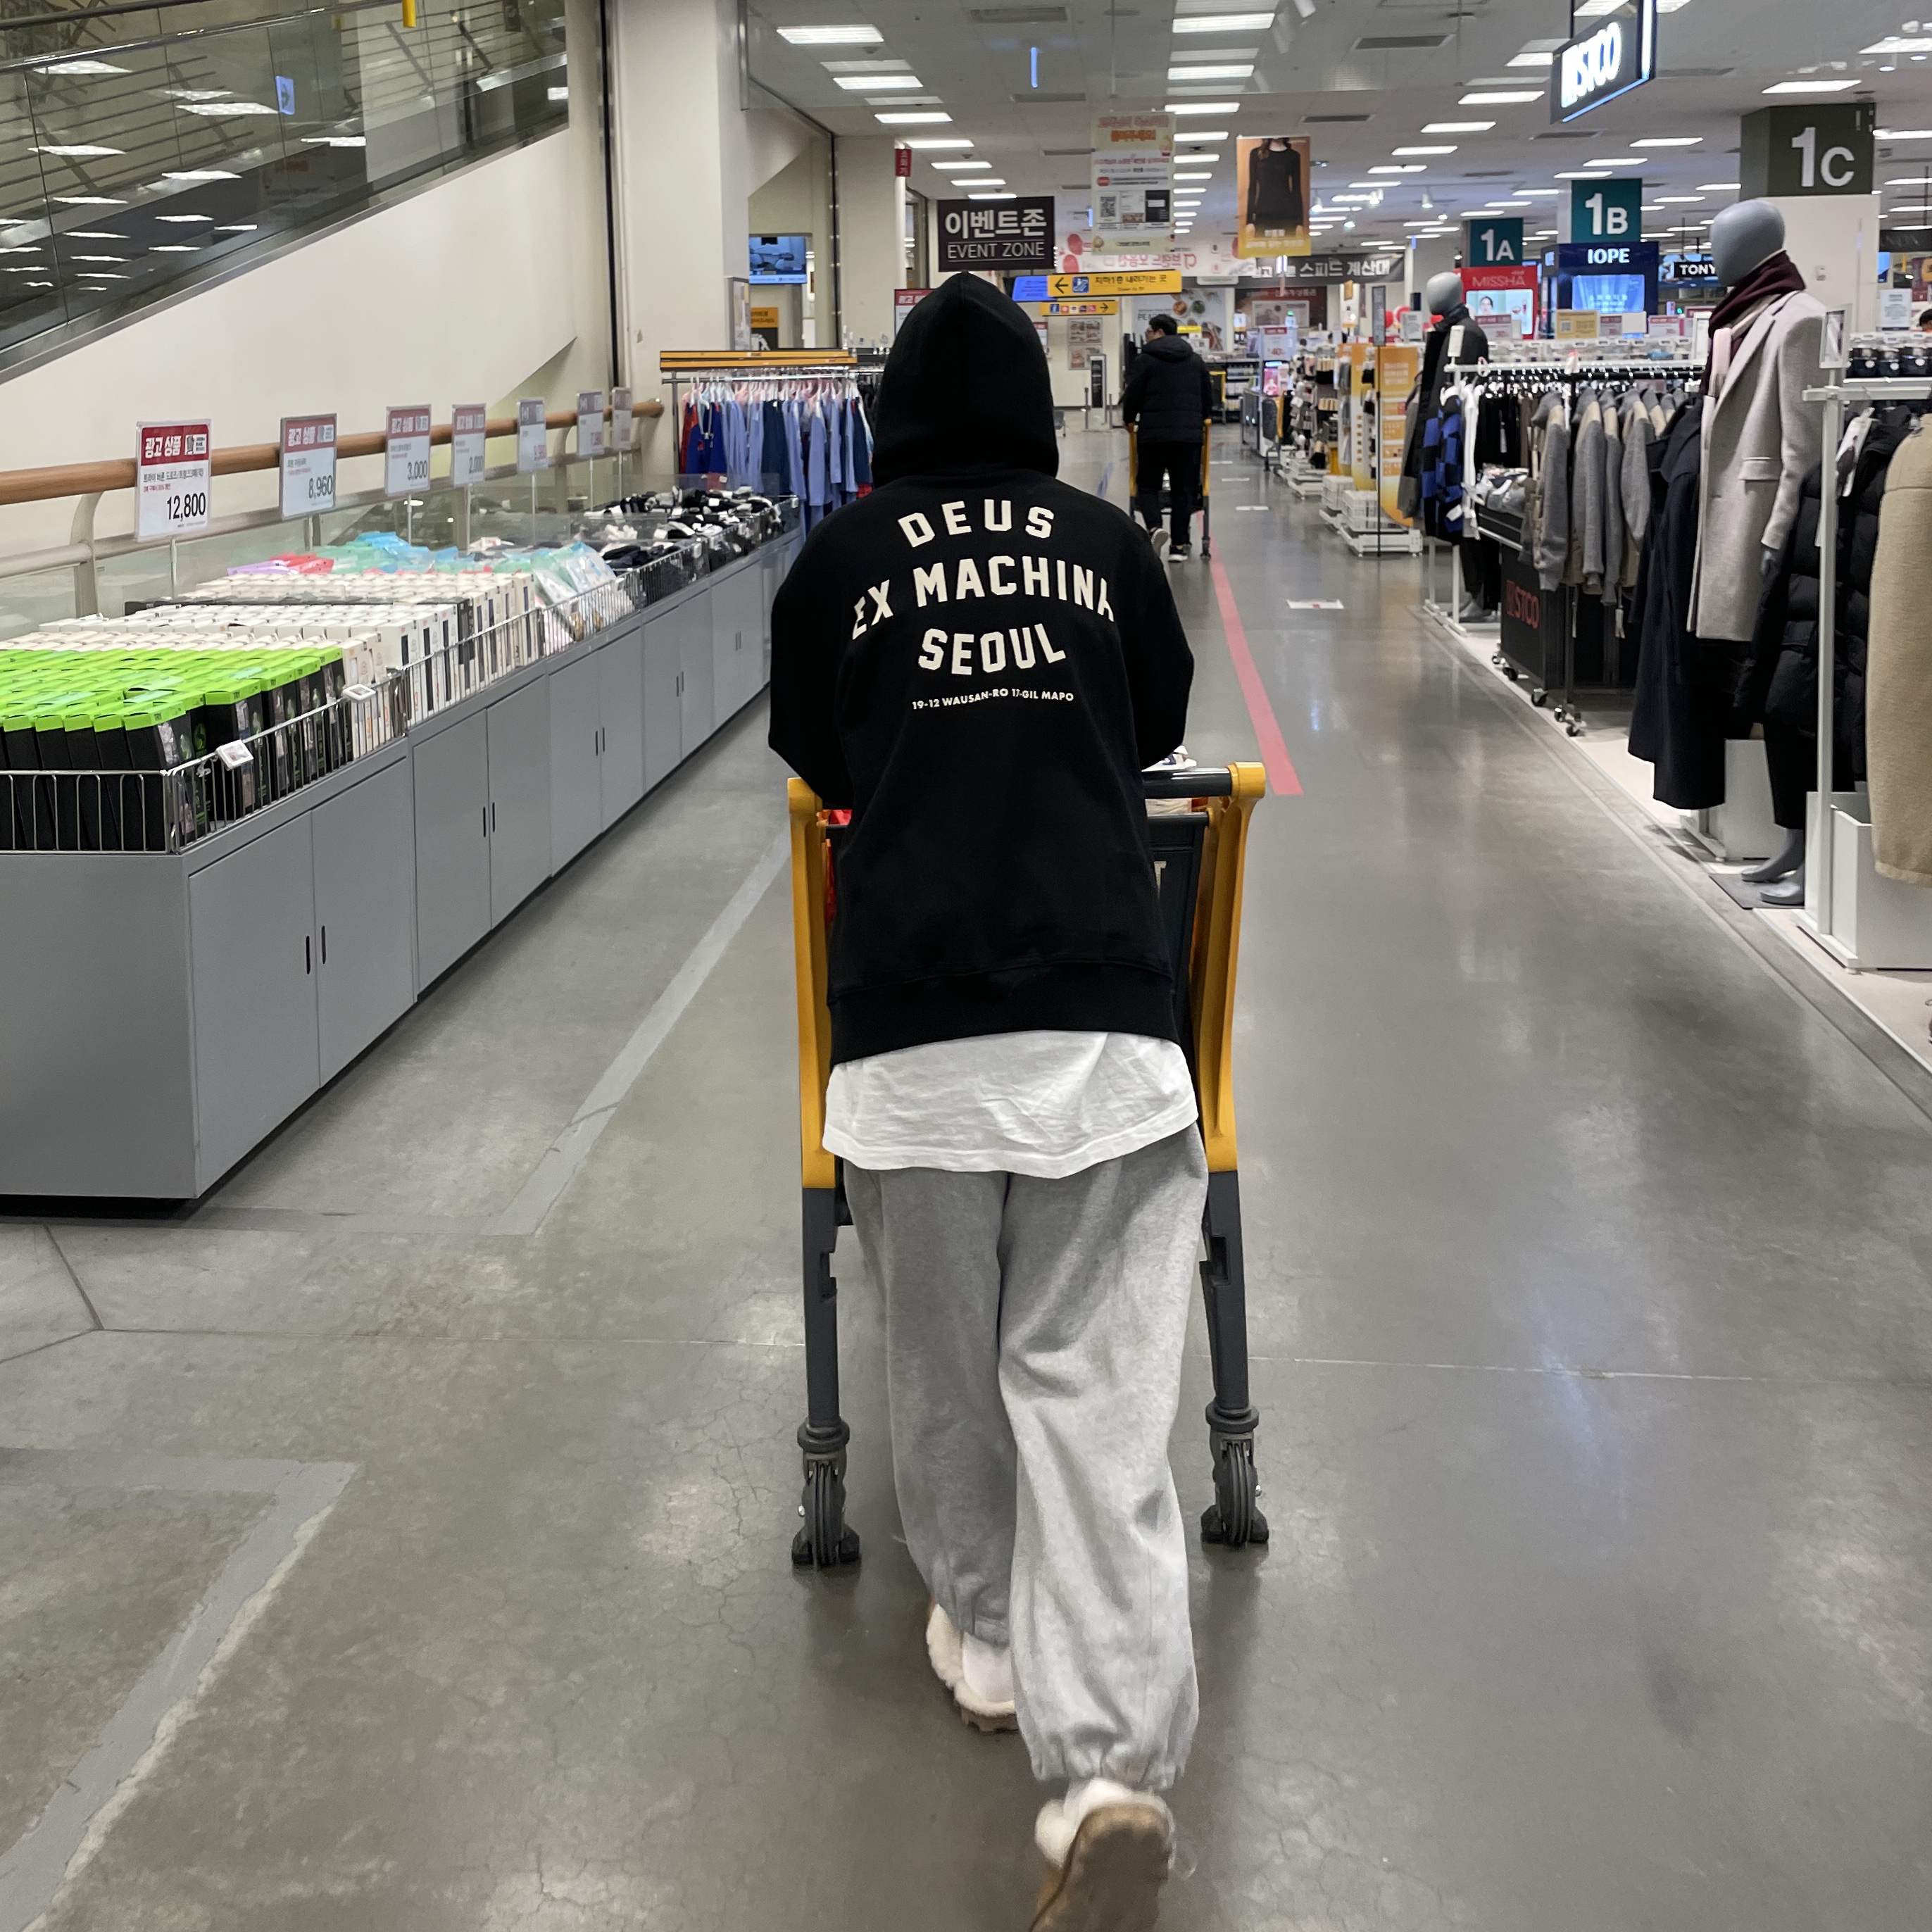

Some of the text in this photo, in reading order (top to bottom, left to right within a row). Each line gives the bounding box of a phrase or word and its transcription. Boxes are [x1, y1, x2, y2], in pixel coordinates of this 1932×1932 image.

[1791, 127, 1855, 187] 1C
[945, 209, 1047, 239] 이벤트존
[1585, 193, 1629, 235] 1B
[948, 242, 1046, 258] EVENT ZONE
[1481, 228, 1514, 261] 1A
[1587, 247, 1631, 264] IOPE
[1299, 258, 1343, 277] 스피드
[1346, 259, 1391, 276] 계산대
[1472, 275, 1526, 287] MISSHA
[144, 435, 182, 458] 광고 상품
[288, 426, 315, 446] 광고 상품
[407, 460, 427, 481] 3,000
[308, 475, 333, 499] 8,960
[167, 492, 206, 522] 12,800
[897, 499, 1055, 547] DEUS
[852, 556, 1115, 640] EX MACHINA
[918, 623, 1067, 675] SEOUL
[912, 699, 940, 710] 19-12
[942, 688, 1009, 706] WAUSAN-RO
[1041, 691, 1074, 701] MAPO
